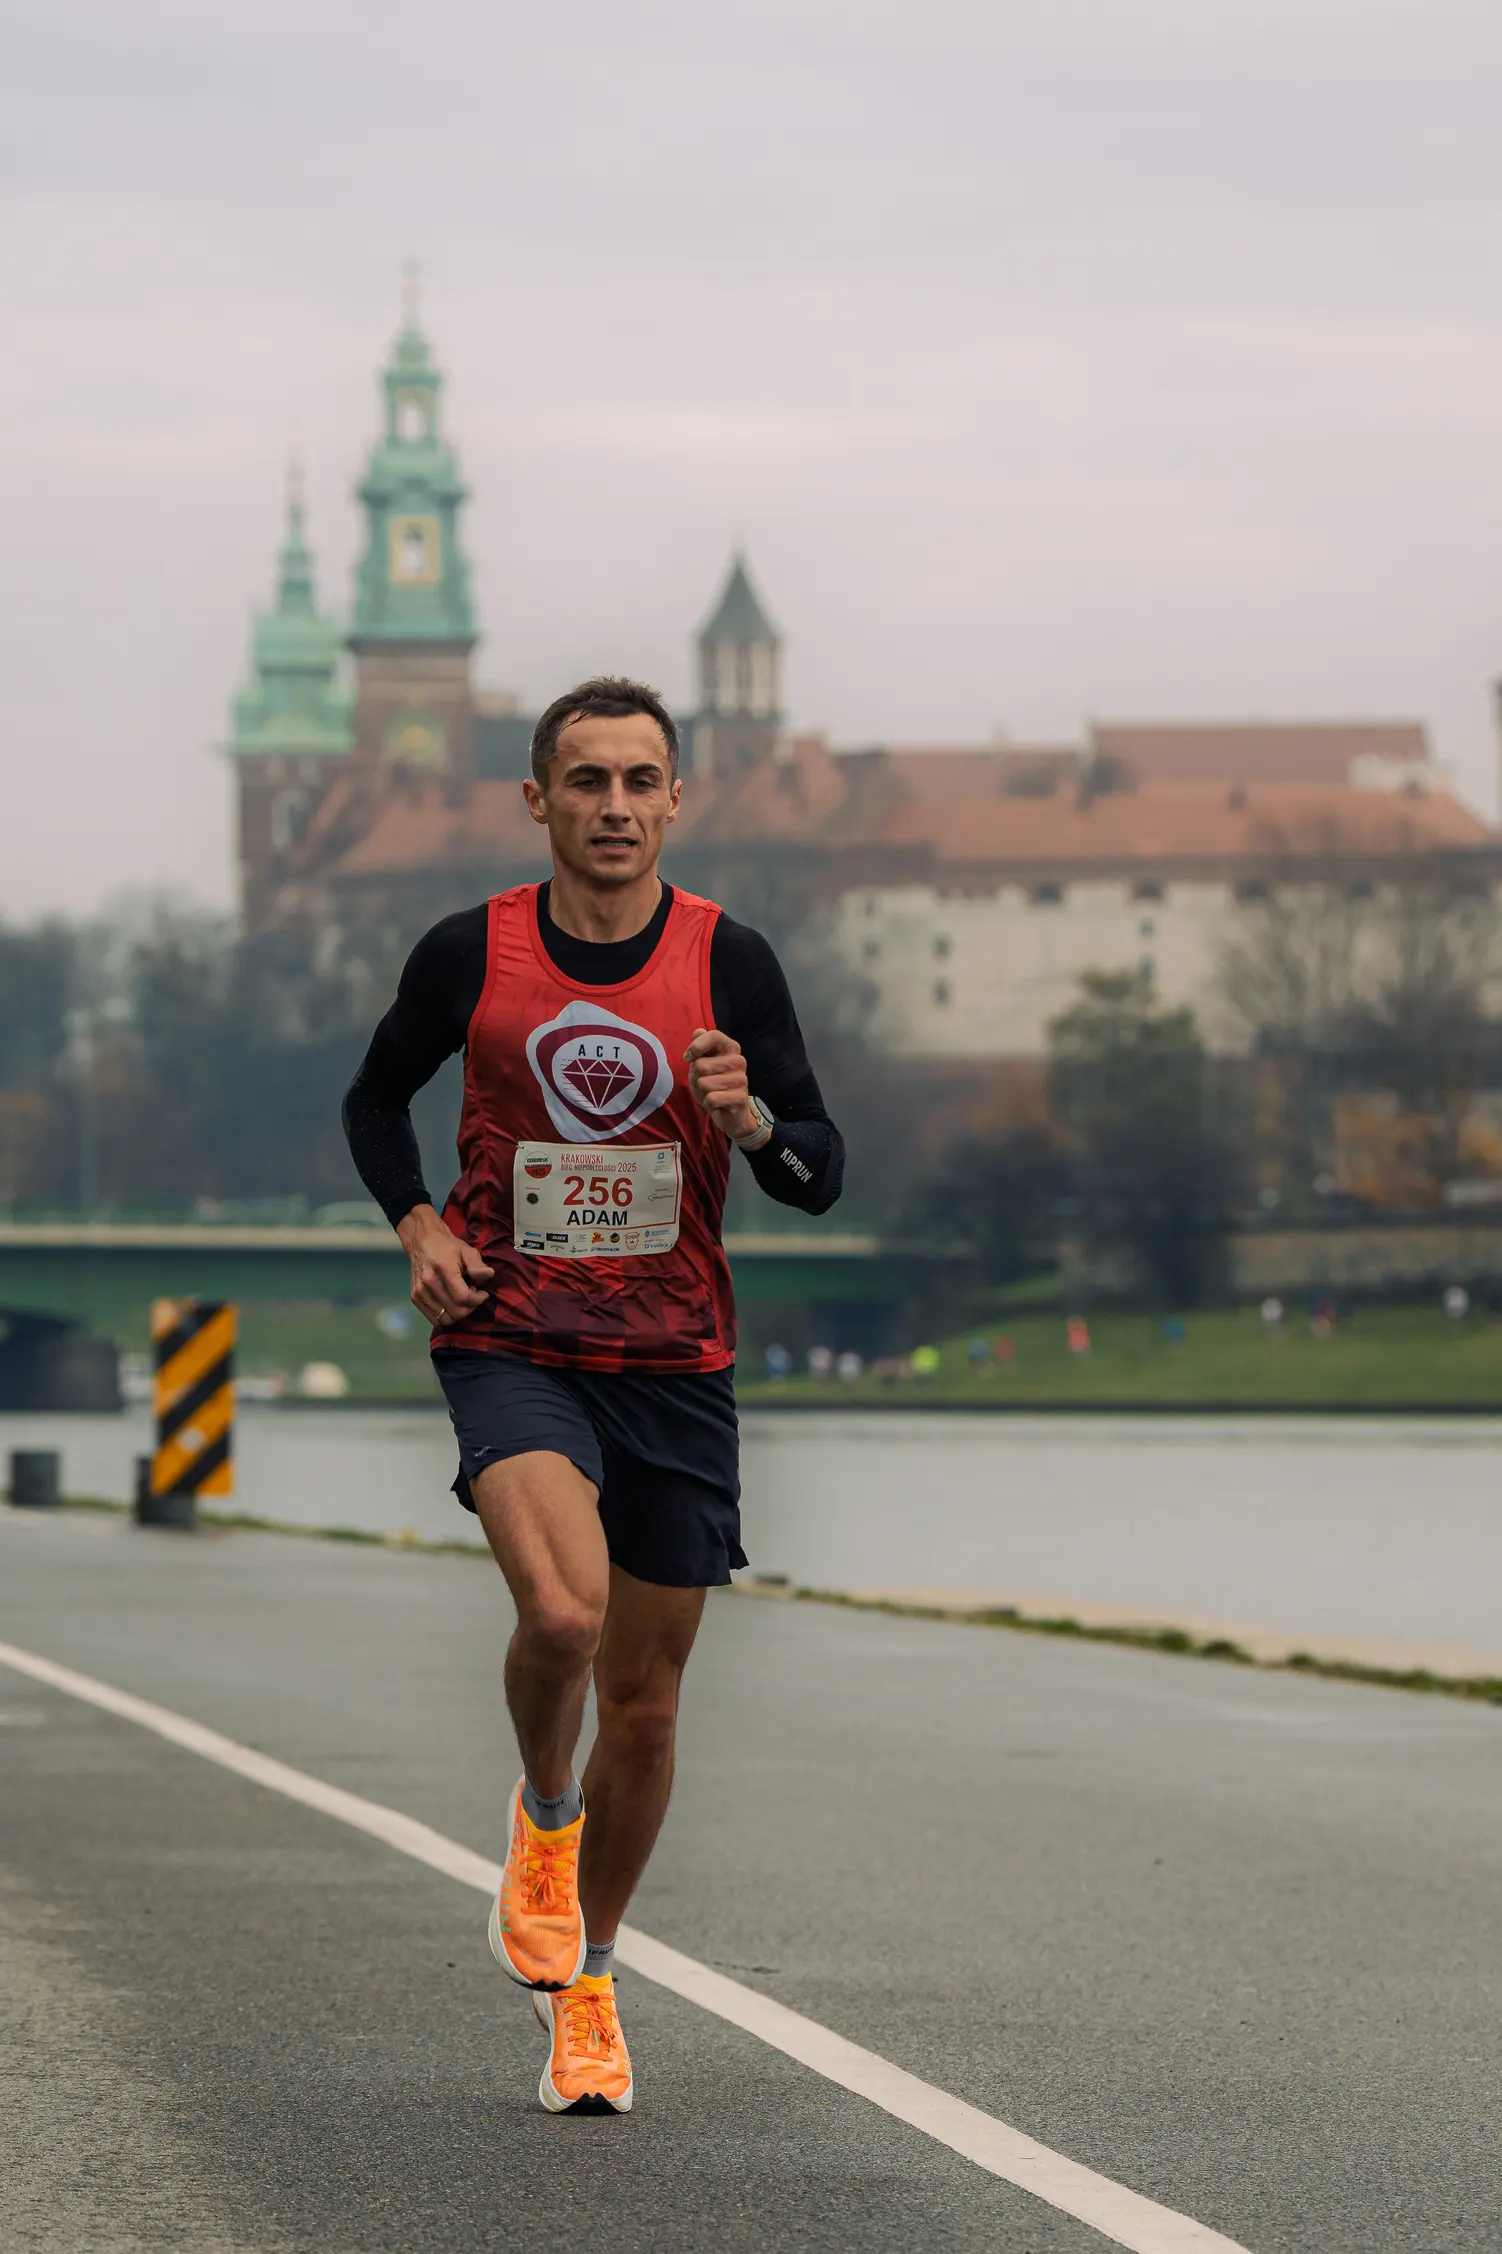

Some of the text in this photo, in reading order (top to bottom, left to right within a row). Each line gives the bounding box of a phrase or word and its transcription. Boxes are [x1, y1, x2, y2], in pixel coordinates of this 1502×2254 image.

[578, 1044, 620, 1059] ACT
[560, 1153, 604, 1165] KRAKOWSKI
[780, 1147, 813, 1184] KIPRUN
[617, 1162, 637, 1173] 2025
[563, 1175, 633, 1208] 256
[566, 1209, 628, 1226] ADAM
